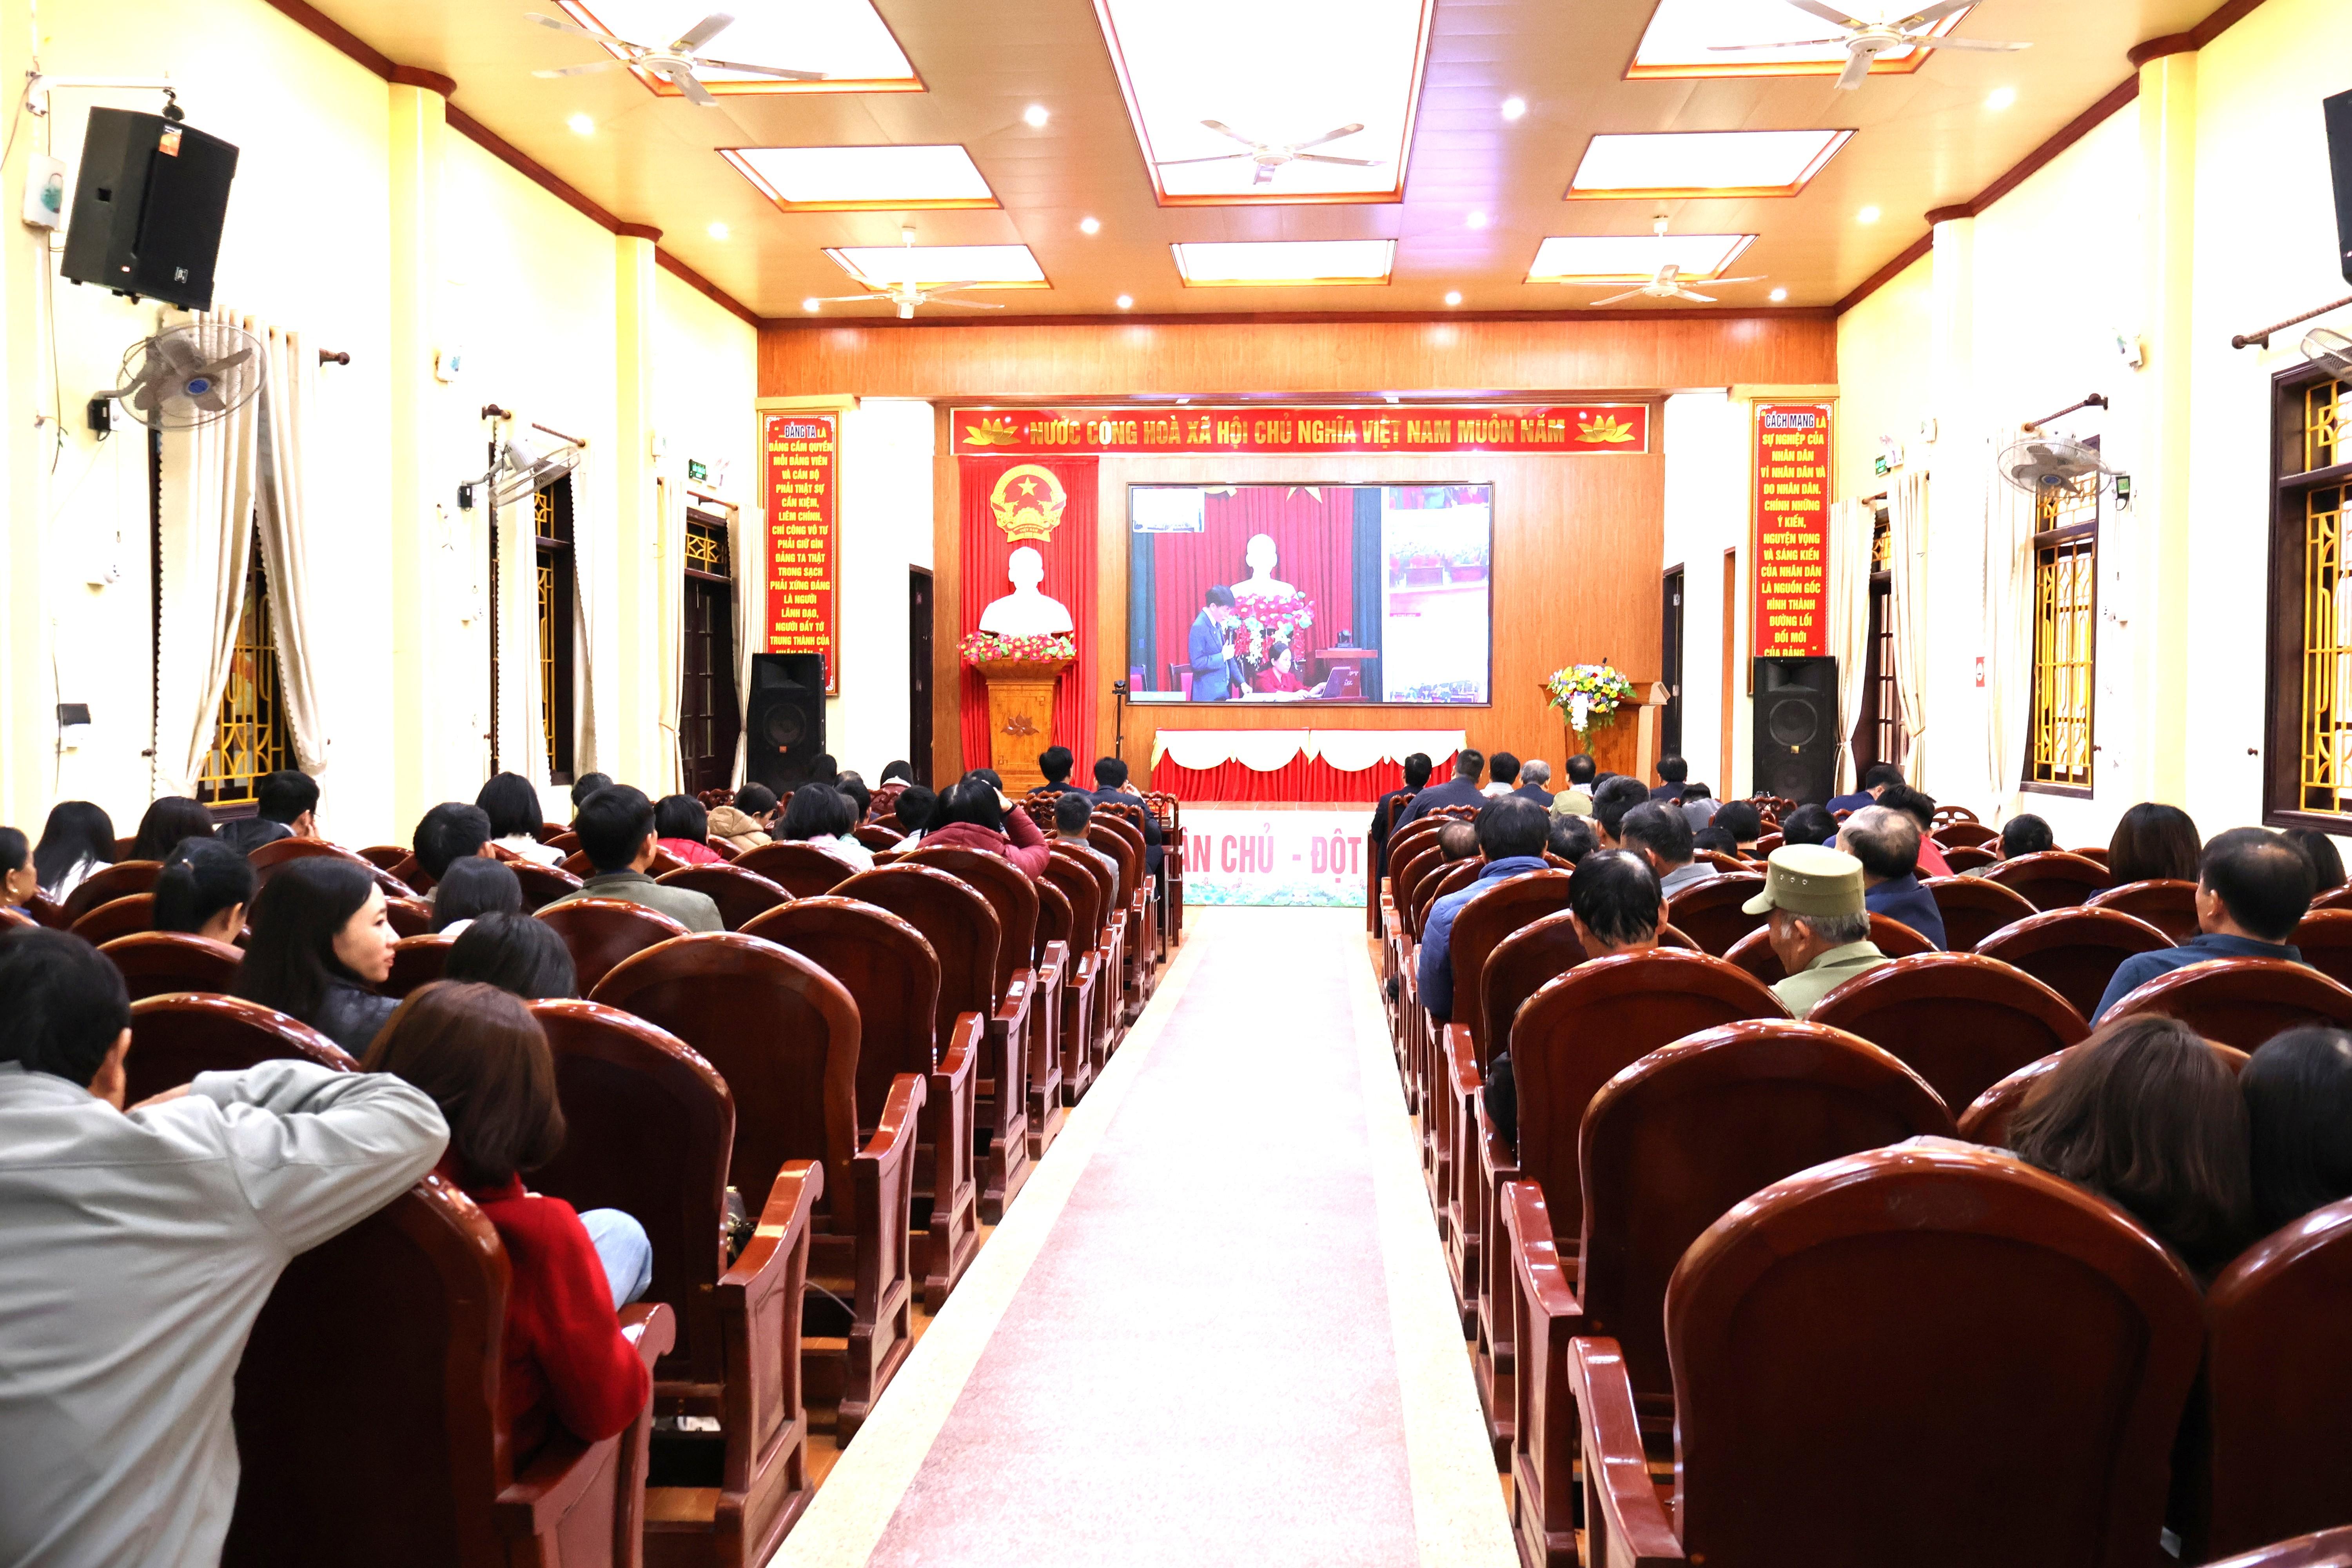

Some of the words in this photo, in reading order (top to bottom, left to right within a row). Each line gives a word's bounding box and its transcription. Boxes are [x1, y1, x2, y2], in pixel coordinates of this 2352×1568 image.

[1789, 414, 1815, 431] MẠNG
[1816, 416, 1826, 428] LÀ
[806, 425, 817, 438] TA
[817, 427, 826, 438] LÀ
[1030, 415, 1080, 445] NƯỚC
[1087, 415, 1137, 449] CỘNG
[1143, 415, 1180, 445] HOÀ
[1187, 416, 1211, 445] XÃ
[1217, 416, 1248, 449] HỘI
[1255, 412, 1291, 445] CHỦ
[1298, 416, 1356, 444] NGHĨA
[1362, 415, 1402, 449] VIỆT
[1408, 419, 1451, 444] NAM
[1457, 413, 1514, 443] MUÔN
[1521, 413, 1565, 443] NĂM
[1762, 433, 1775, 447] SỰ
[1775, 432, 1806, 447] NGHIỆP
[1808, 431, 1824, 445] CỦA
[769, 440, 789, 452] ĐẢNG
[789, 454, 809, 465] ĐẢNG
[811, 455, 828, 465] VIÊN
[1772, 449, 1795, 461] NHÂN
[1797, 449, 1814, 461] DÂN
[782, 469, 791, 479] VÀ
[793, 469, 808, 479] CÁN
[809, 469, 819, 481] BỘ
[1761, 465, 1769, 478] VÌ
[1772, 465, 1795, 478] NHÂN
[1797, 465, 1814, 478] DÂN
[1815, 465, 1826, 478] VÀ
[776, 481, 793, 493] PHẢI
[795, 483, 812, 495] THẬT
[814, 484, 825, 495] SỰ
[1764, 484, 1775, 494] DO
[1777, 482, 1800, 494] NHÂN
[1802, 482, 1821, 494] DÂN.
[799, 497, 819, 509] KIỆM,
[1764, 498, 1789, 511] CHÍNH
[1791, 499, 1820, 511] NHỮNG
[779, 510, 796, 521] LIÊM
[798, 510, 822, 522] CHÍNH,
[1778, 515, 1783, 527] Ý
[1785, 514, 1806, 529] KIẾN,
[772, 524, 784, 535] CHÍ
[786, 524, 806, 535] CÔNG
[808, 524, 817, 535] VÔ
[819, 525, 829, 535] TƯ
[778, 537, 795, 548] PHẢI
[797, 538, 810, 549] GIỮ
[811, 538, 823, 549] GÌN
[1764, 532, 1796, 546] NGUYỆN
[1798, 534, 1820, 546] VỌNG
[776, 551, 795, 562] ĐẢNG
[797, 554, 806, 562] TA
[808, 552, 826, 564] THẬT
[1764, 548, 1774, 561] VÀ
[1776, 548, 1798, 561] SÁNG
[1800, 547, 1819, 561] KIẾN
[778, 567, 802, 576] TRONG
[804, 567, 823, 578] SẠCH
[1761, 563, 1777, 577] CỦA
[1780, 564, 1802, 577] NHÂN
[1805, 564, 1822, 577] DÂN
[770, 579, 787, 590] PHẢI
[789, 580, 809, 590] XỨNG
[811, 580, 830, 590] ĐÁNG
[1762, 581, 1771, 593] LÀ
[1804, 580, 1821, 593] GỐC
[784, 593, 793, 604] LÀ
[795, 593, 817, 604] NGƯỜI
[1767, 598, 1786, 610] HÌNH
[1788, 598, 1815, 610] THÀNH
[781, 608, 800, 618] LÃNH
[802, 608, 818, 619] ĐẠO,
[1769, 613, 1797, 626] ĐƯỜNG
[1799, 613, 1812, 626] LỐI
[776, 621, 797, 632] NGƯỜI
[815, 621, 824, 632] TỚ
[770, 636, 791, 645] TRUNG
[793, 635, 815, 645] THÀNH
[817, 634, 830, 646] CỦA
[1791, 631, 1806, 643] MỚI
[1764, 646, 1780, 656] CỦA
[1182, 826, 1211, 873] ÂN
[1221, 822, 1274, 873] CHỦ
[1310, 828, 1361, 883] ĐỘT
